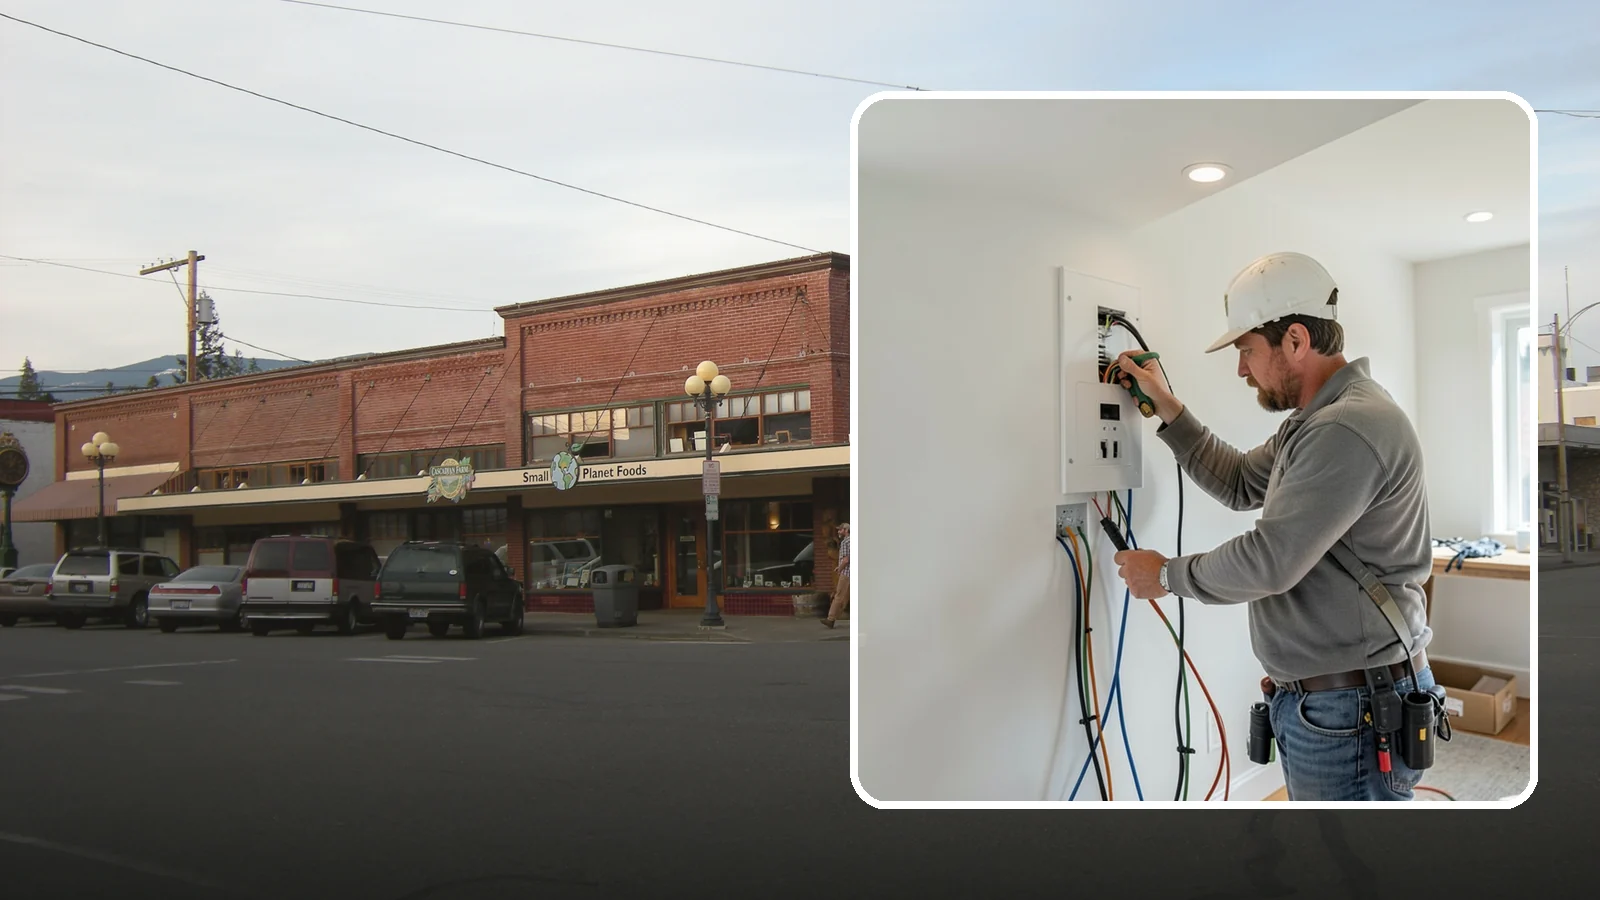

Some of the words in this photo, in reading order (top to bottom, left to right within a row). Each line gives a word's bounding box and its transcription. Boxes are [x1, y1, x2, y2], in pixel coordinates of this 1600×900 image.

[522, 471, 549, 483] Small
[582, 467, 615, 479] Planet
[616, 464, 648, 477] Foods
